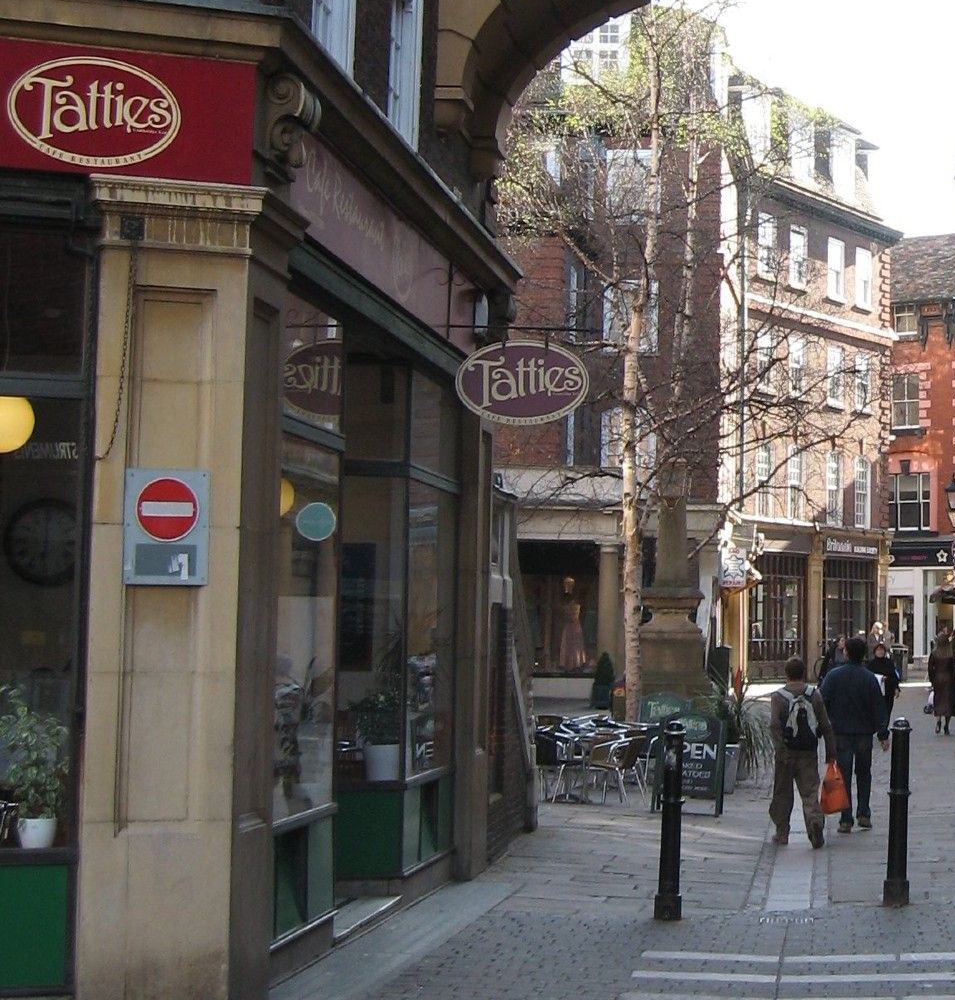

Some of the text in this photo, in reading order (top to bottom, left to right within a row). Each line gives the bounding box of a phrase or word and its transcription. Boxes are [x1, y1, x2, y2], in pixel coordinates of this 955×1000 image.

[24, 75, 172, 140] Tatties
[71, 153, 143, 166] RESTAURANT
[467, 355, 582, 409] Tatties
[683, 742, 717, 760] PEN
